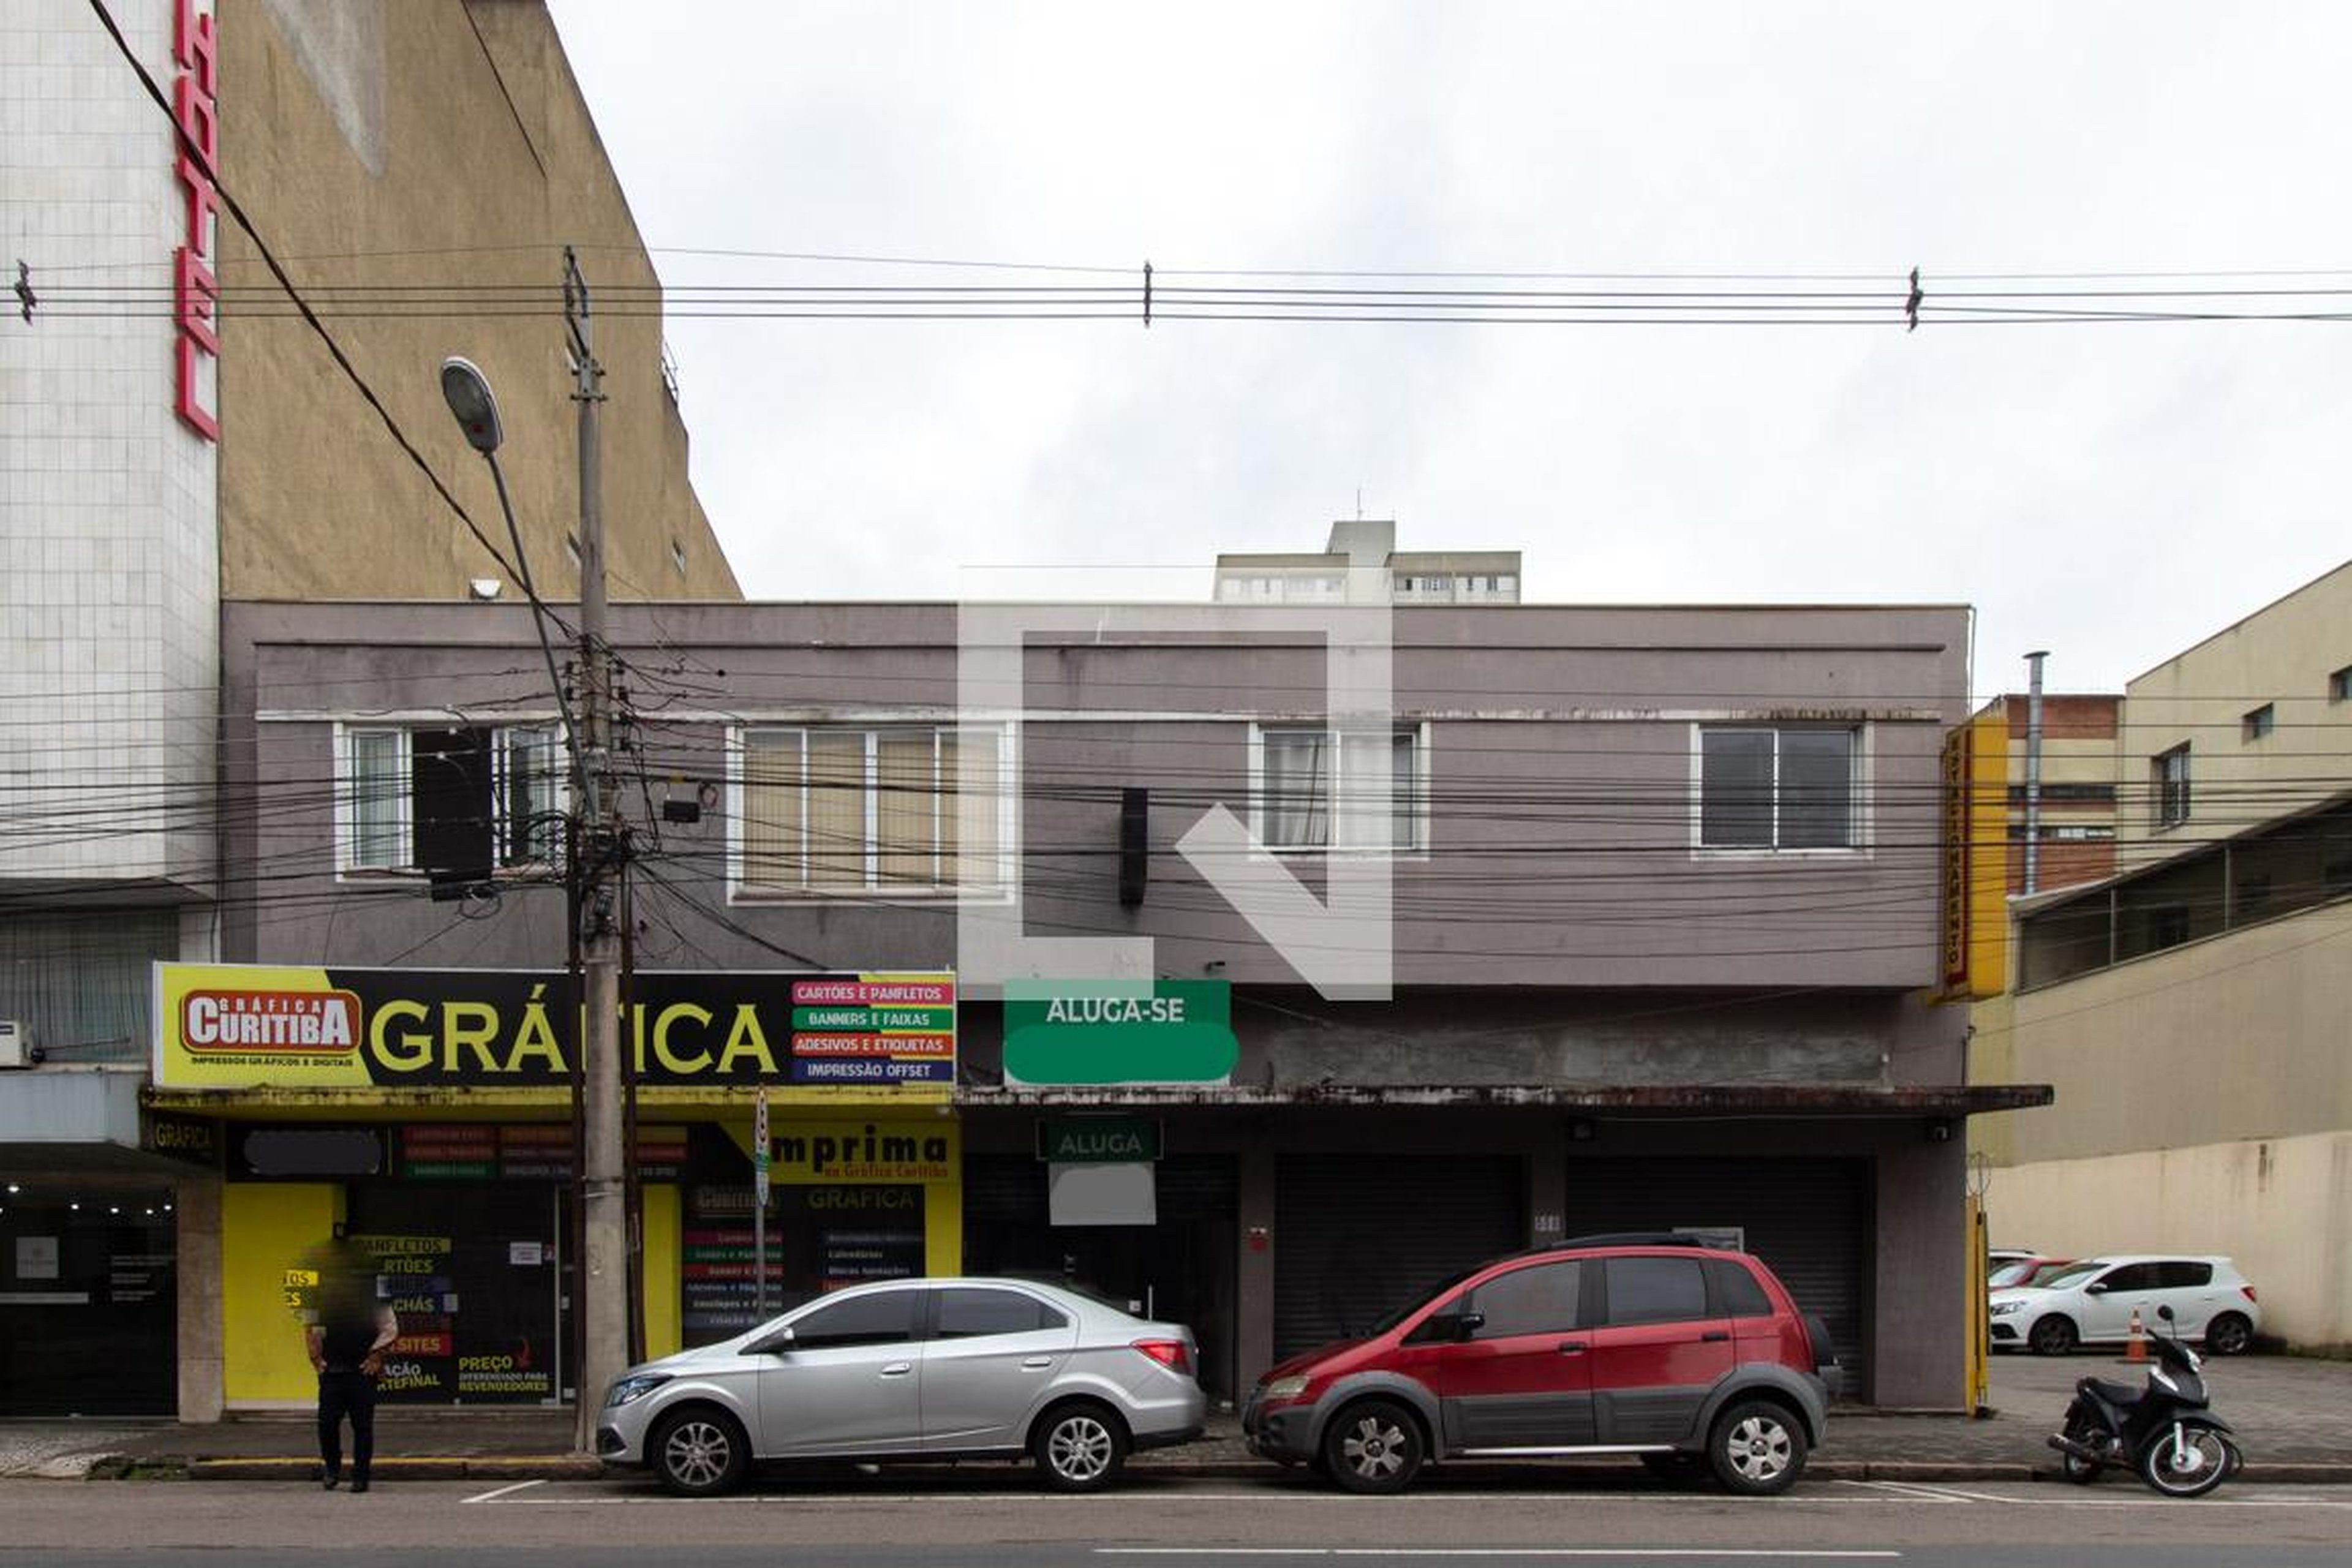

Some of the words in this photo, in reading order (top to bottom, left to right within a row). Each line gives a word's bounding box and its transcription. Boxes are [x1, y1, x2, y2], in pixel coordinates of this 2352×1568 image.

[174, 0, 221, 444] HOTEL
[797, 986, 854, 1000] CARTÕES
[859, 987, 867, 999] E
[870, 987, 943, 1000] PANFLETOS
[219, 997, 321, 1014] GRÁFICA
[1046, 997, 1185, 1023] ALUGA-SE
[188, 997, 352, 1046] CURITIBA
[809, 1012, 867, 1026] BANNERS
[871, 1013, 878, 1025] E
[883, 1014, 930, 1026] FAIXAS
[796, 1038, 858, 1051] ADESIVOS
[862, 1039, 870, 1051] E
[874, 1039, 944, 1052] ETIQUETAS
[807, 1063, 883, 1077] IMPRESSÃO
[886, 1065, 931, 1077] OFFSET
[770, 1123, 948, 1173] mprima
[1059, 1133, 1143, 1154] ALUGA
[361, 1238, 442, 1253] ANFLETOS
[383, 1254, 434, 1273] RTÕES
[393, 1295, 435, 1312] CHÁS
[396, 1337, 441, 1352] SITES
[384, 1360, 421, 1377] AÇÃO
[458, 1355, 514, 1372] PREÇO
[376, 1373, 442, 1392] RTEFINAL
